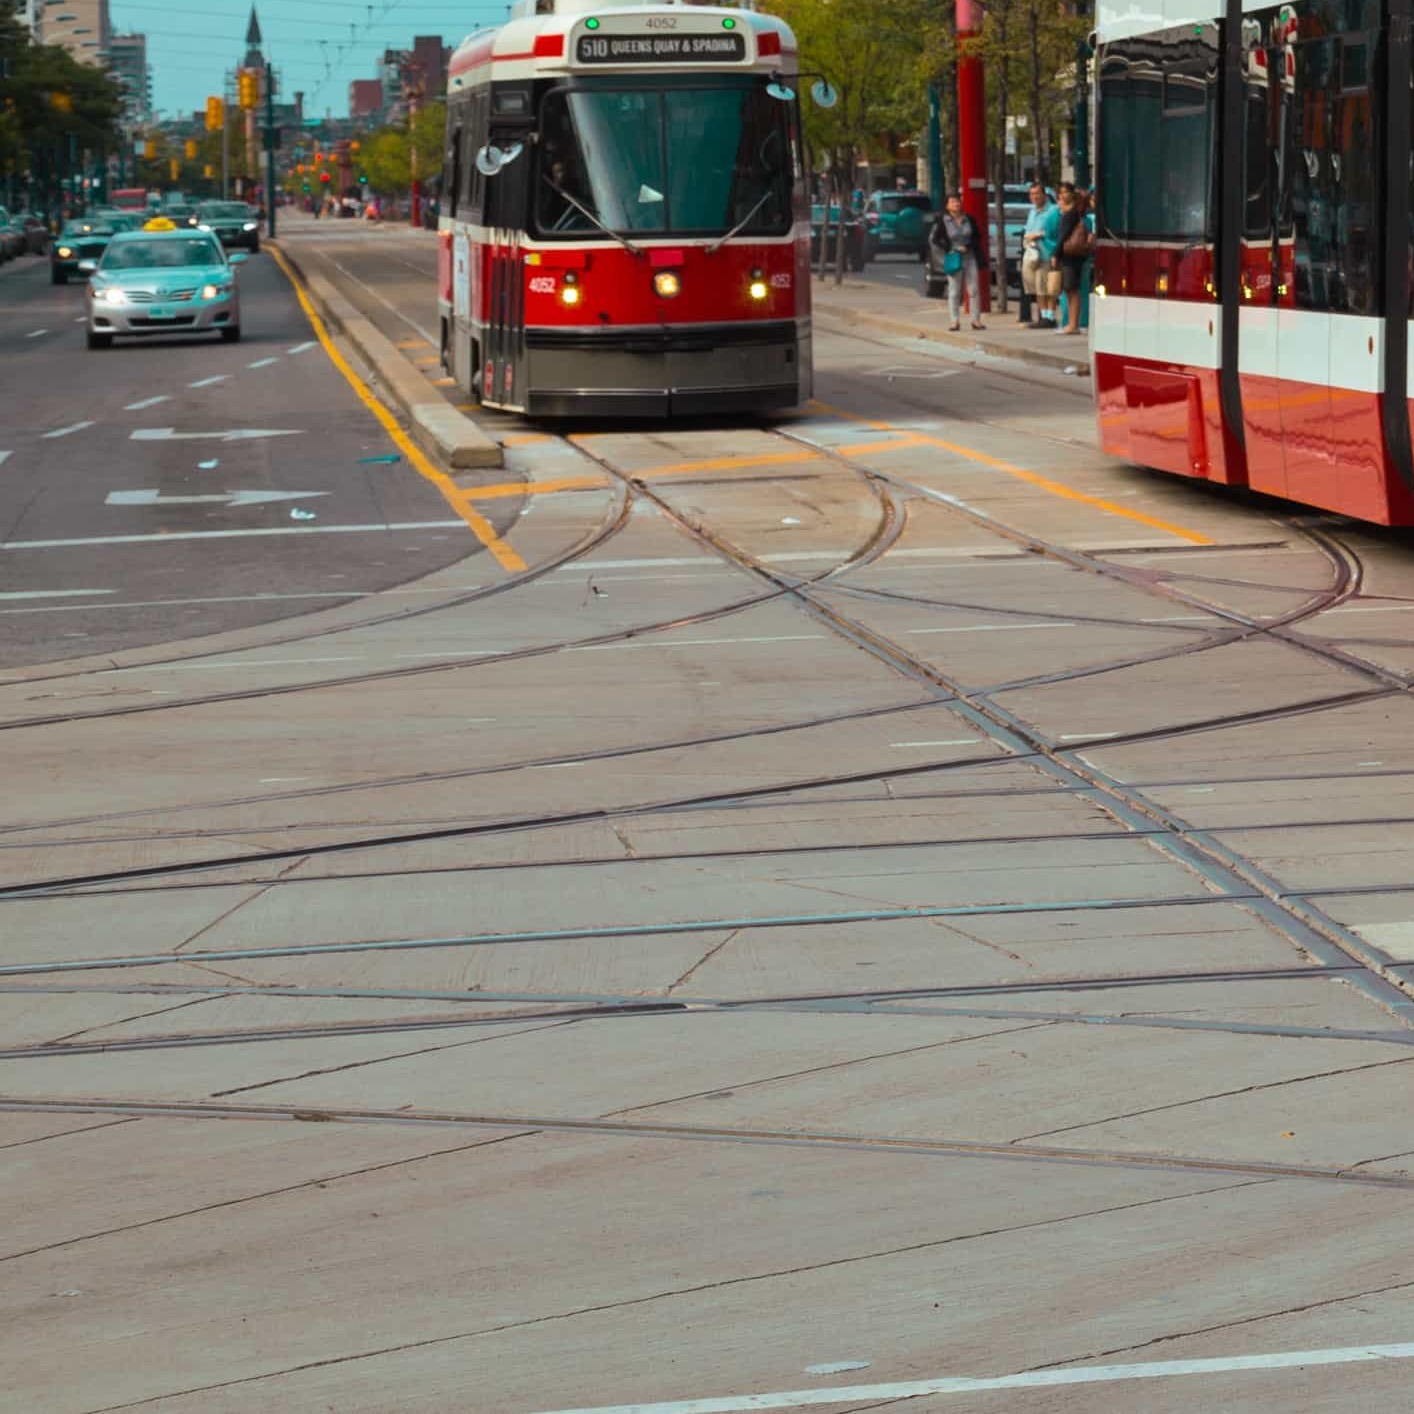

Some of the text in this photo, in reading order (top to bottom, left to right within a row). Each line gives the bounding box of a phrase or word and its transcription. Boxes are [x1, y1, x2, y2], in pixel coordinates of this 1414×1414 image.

[645, 17, 677, 29] 4052
[582, 38, 737, 58] 510 QUEENS QUAY & SPADINA
[529, 276, 556, 293] 4052
